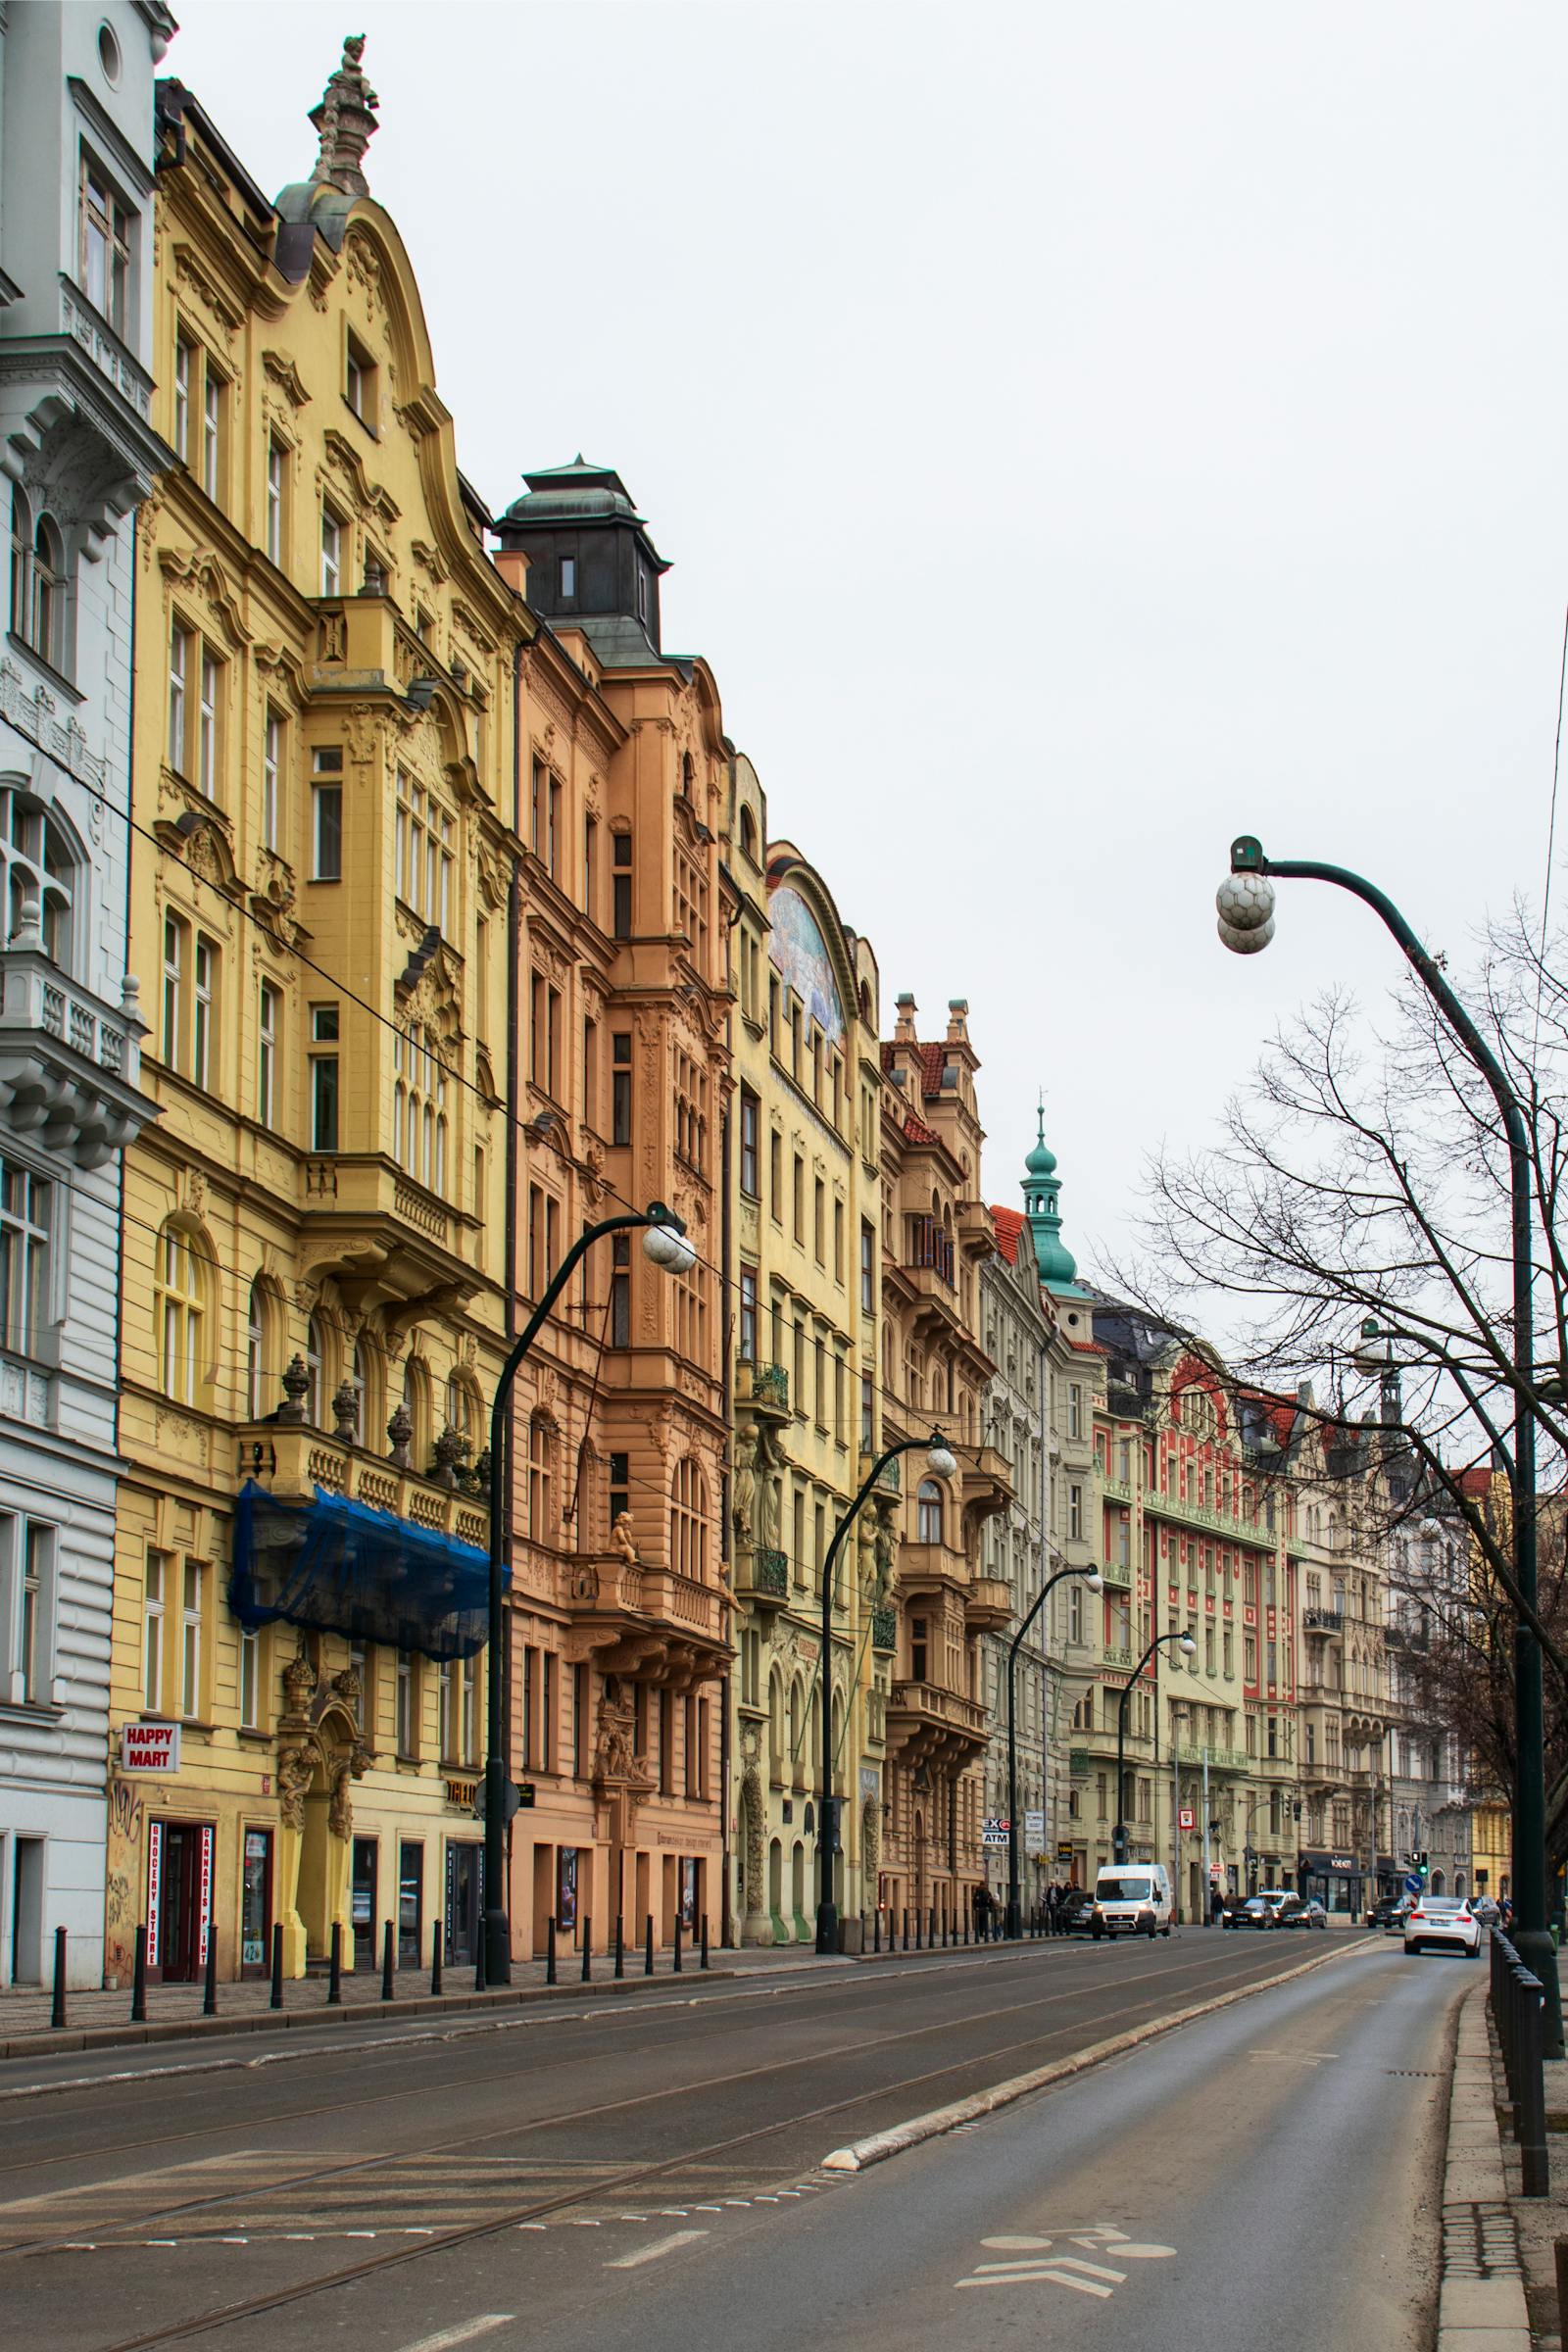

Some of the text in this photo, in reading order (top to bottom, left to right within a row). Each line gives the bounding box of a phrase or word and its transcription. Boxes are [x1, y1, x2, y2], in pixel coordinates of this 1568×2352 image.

[127, 1729, 172, 1744] HAPPY
[129, 1750, 170, 1767] MART
[985, 1835, 1007, 1843] ATM
